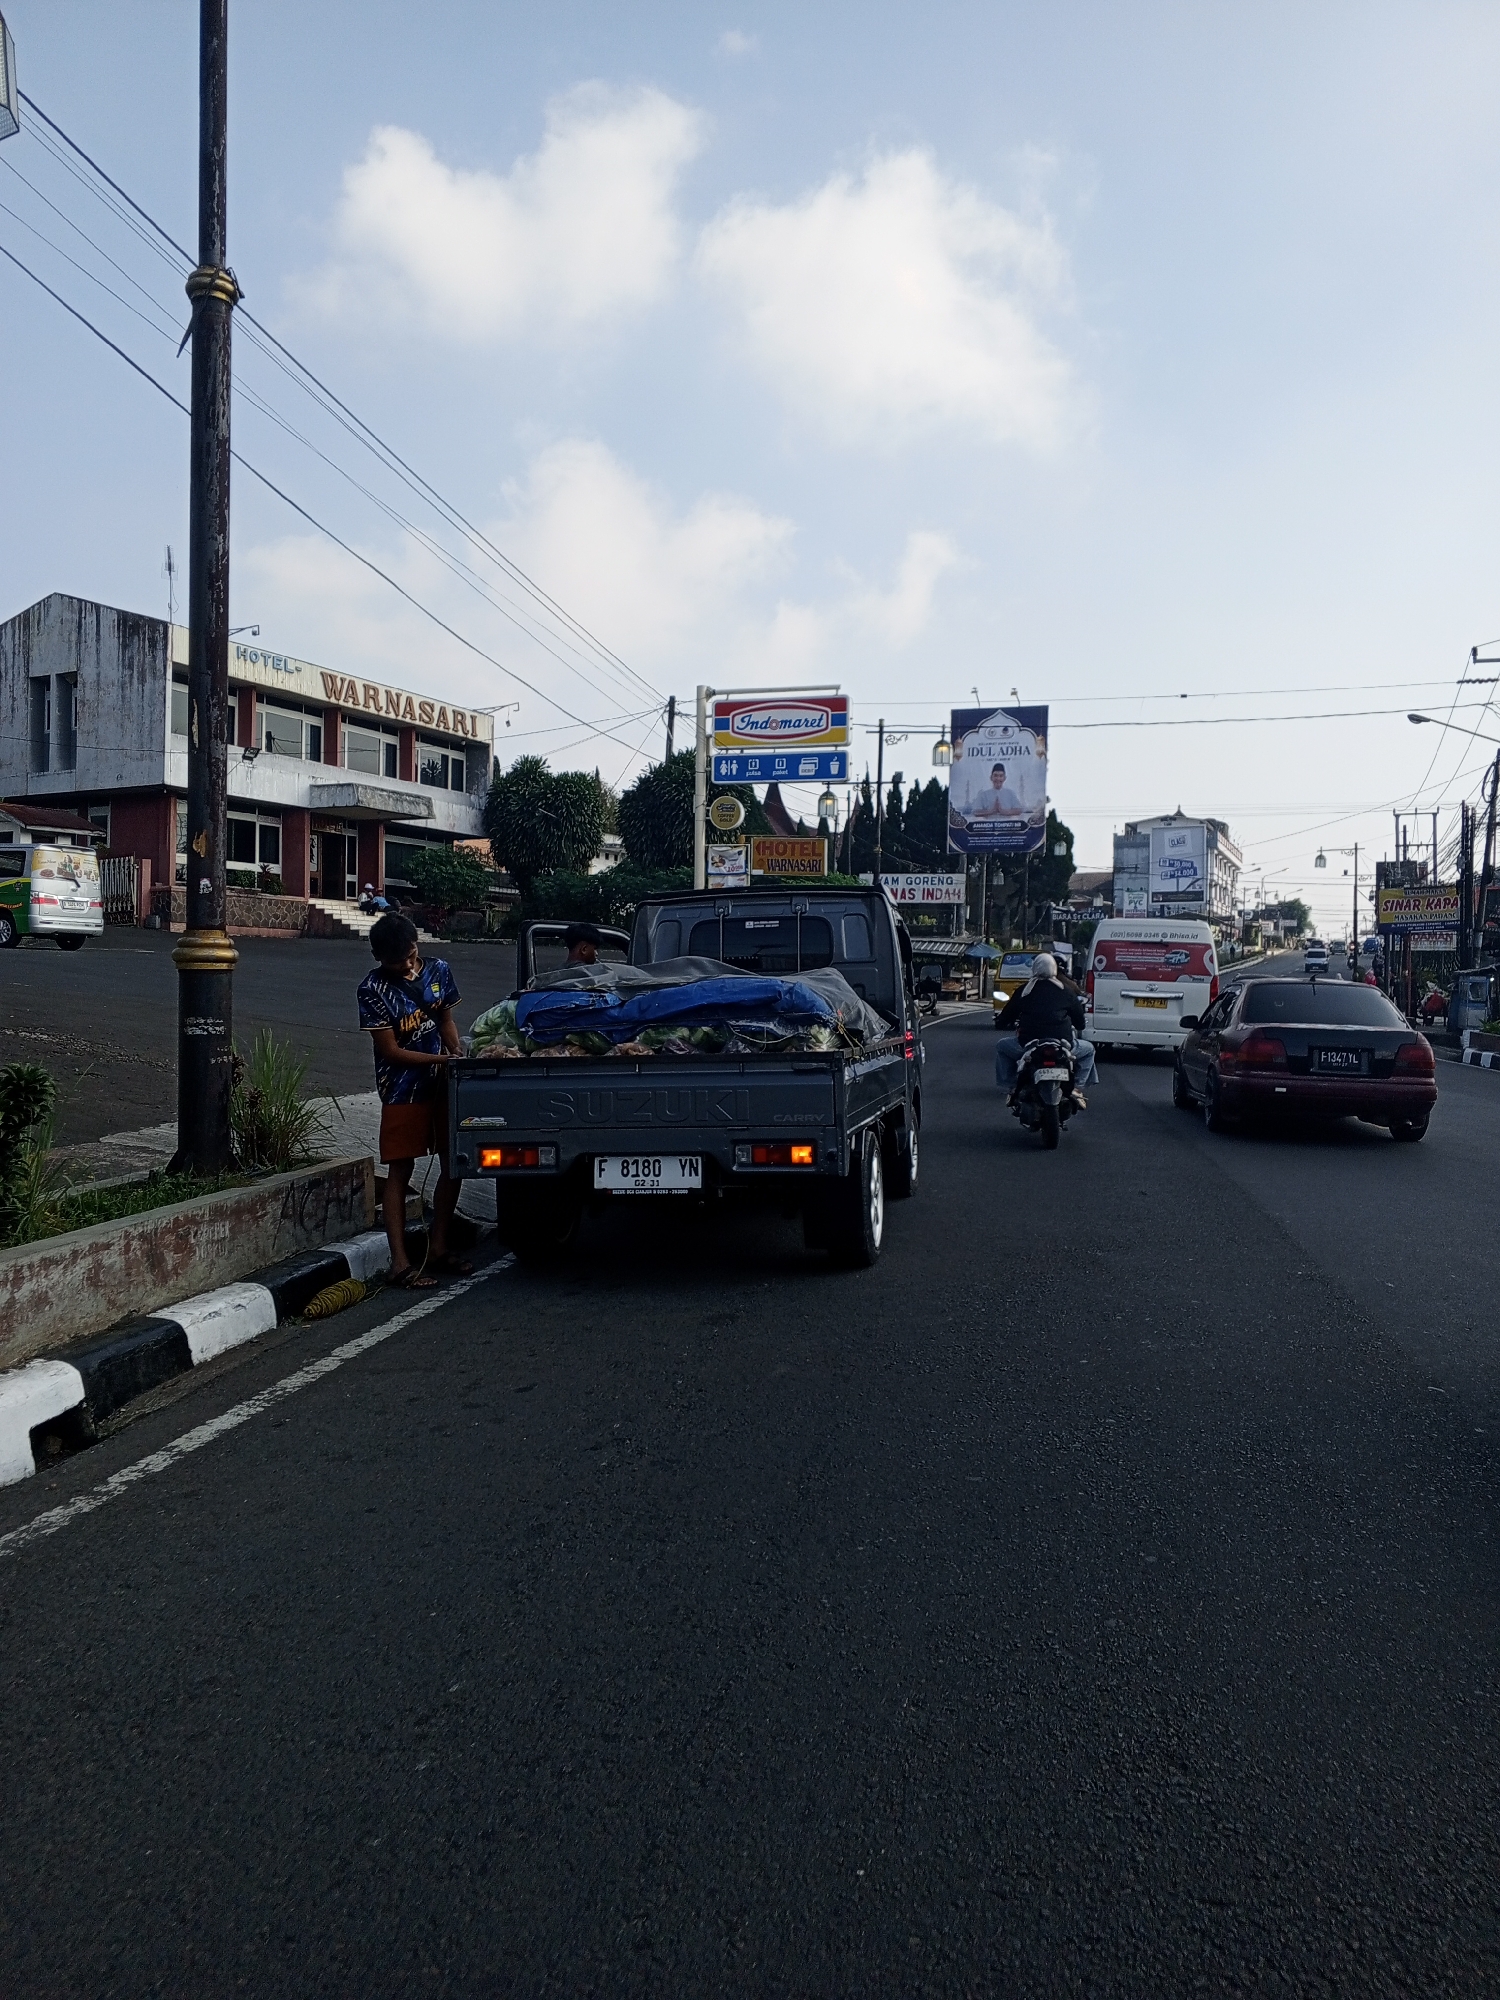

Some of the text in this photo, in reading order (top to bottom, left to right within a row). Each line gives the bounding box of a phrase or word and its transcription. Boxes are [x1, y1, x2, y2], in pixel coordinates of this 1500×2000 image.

[320, 671, 478, 738] WARNASARI
[736, 713, 825, 732] Indomaret
[967, 745, 1031, 757] IDUL ADHA
[772, 769, 789, 777] paket
[761, 841, 822, 857] HOTEL
[767, 858, 822, 872] WARNASARI
[905, 876, 954, 886] GORENG
[1382, 899, 1422, 912] SINAR
[1321, 1051, 1359, 1064] F 1347 YL
[538, 1089, 750, 1124] SUZUKI
[773, 1114, 825, 1122] CARRY
[598, 1158, 699, 1178] F 8180 YN
